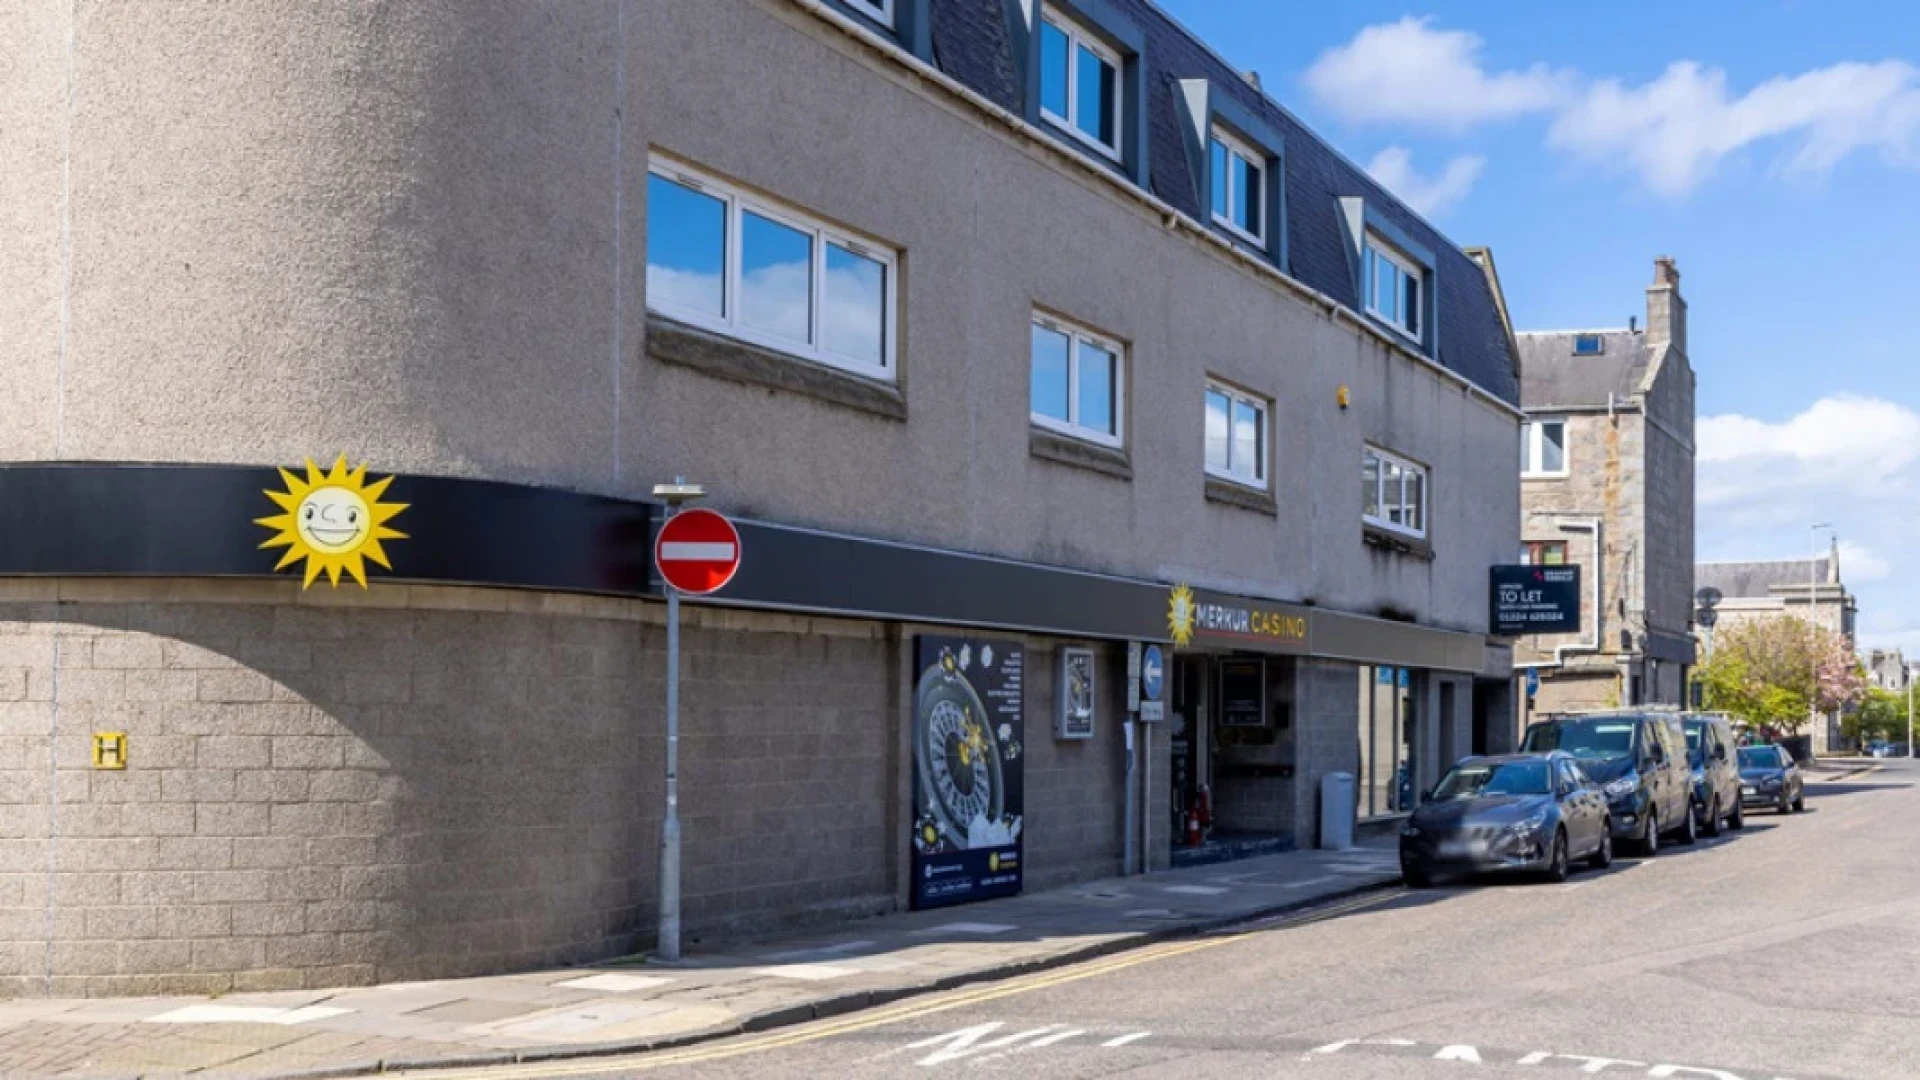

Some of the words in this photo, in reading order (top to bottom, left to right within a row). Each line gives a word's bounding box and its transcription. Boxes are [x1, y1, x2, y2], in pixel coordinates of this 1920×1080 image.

[1500, 590, 1518, 602] TO
[1520, 590, 1542, 602] LET
[1196, 604, 1249, 632] MERKUR
[1251, 611, 1306, 638] CASINO
[98, 736, 121, 764] H
